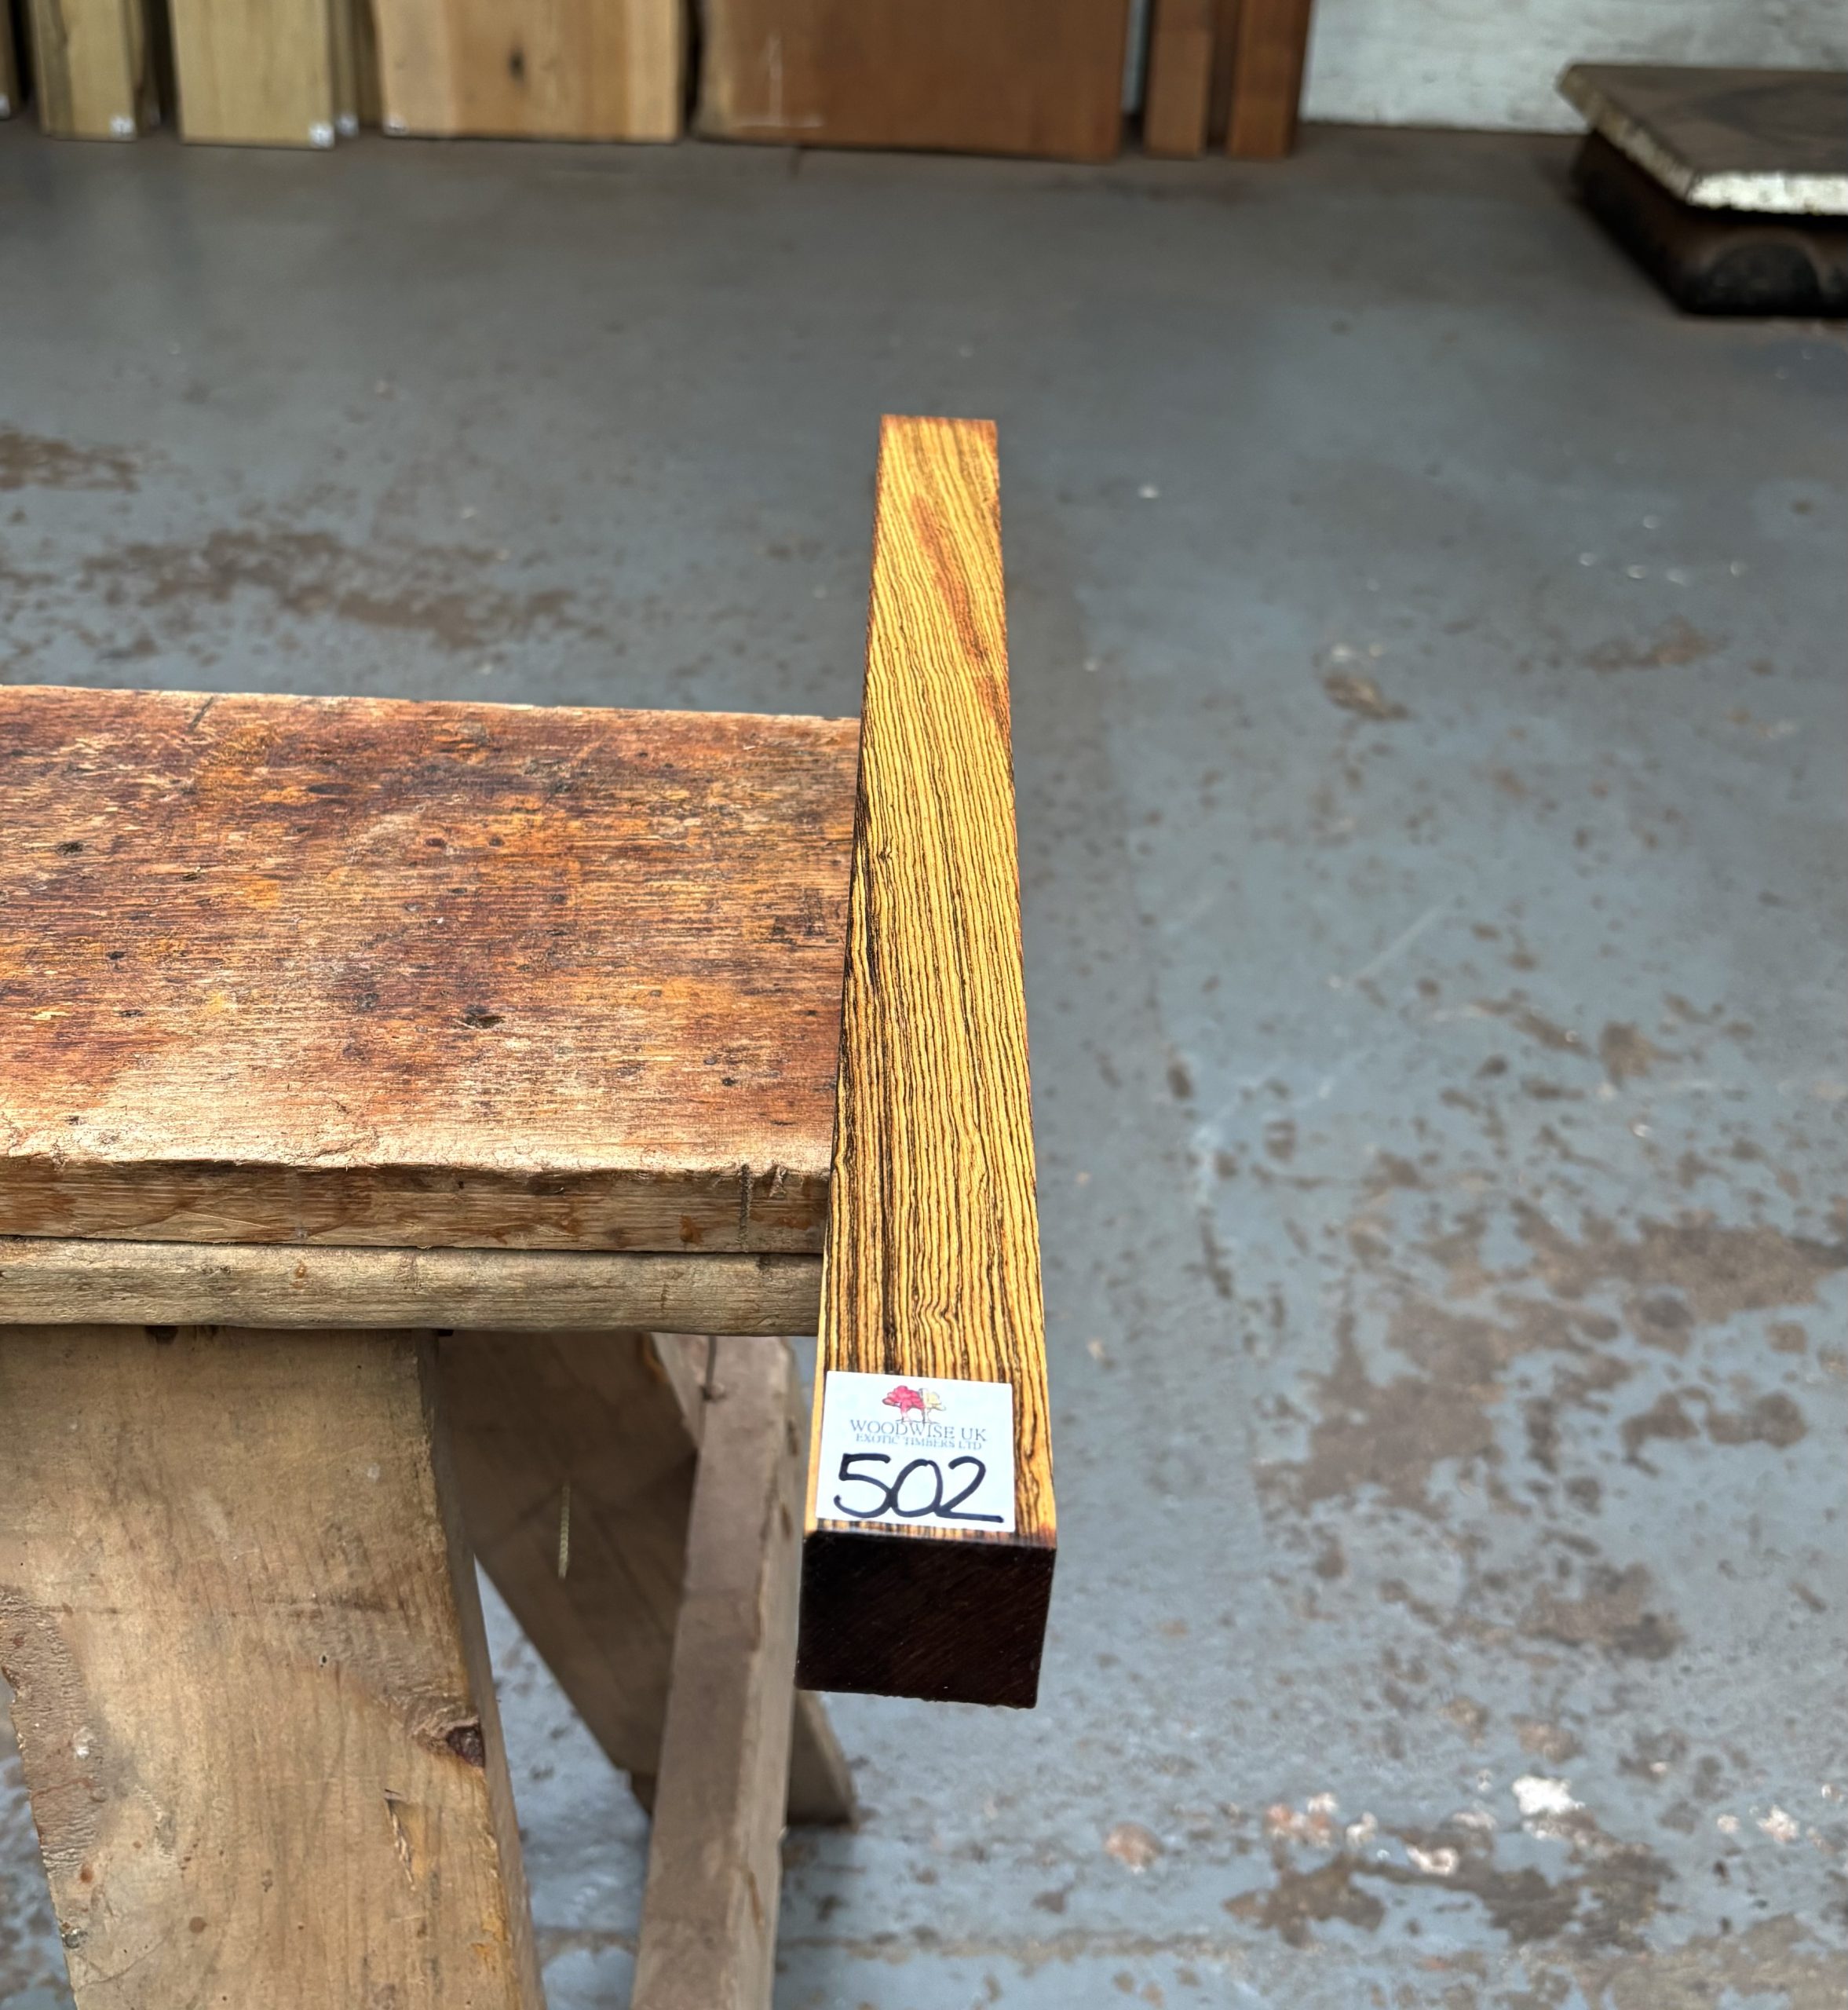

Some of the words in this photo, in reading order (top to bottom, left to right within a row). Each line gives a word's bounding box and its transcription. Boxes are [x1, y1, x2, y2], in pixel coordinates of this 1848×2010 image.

[850, 1419, 955, 1439] WOODWISE
[961, 1427, 987, 1442] UK
[856, 1433, 900, 1445] EXOTIC
[903, 1436, 955, 1449] TIMBERS
[959, 1440, 983, 1451] LTD
[834, 1453, 1004, 1523] 502
